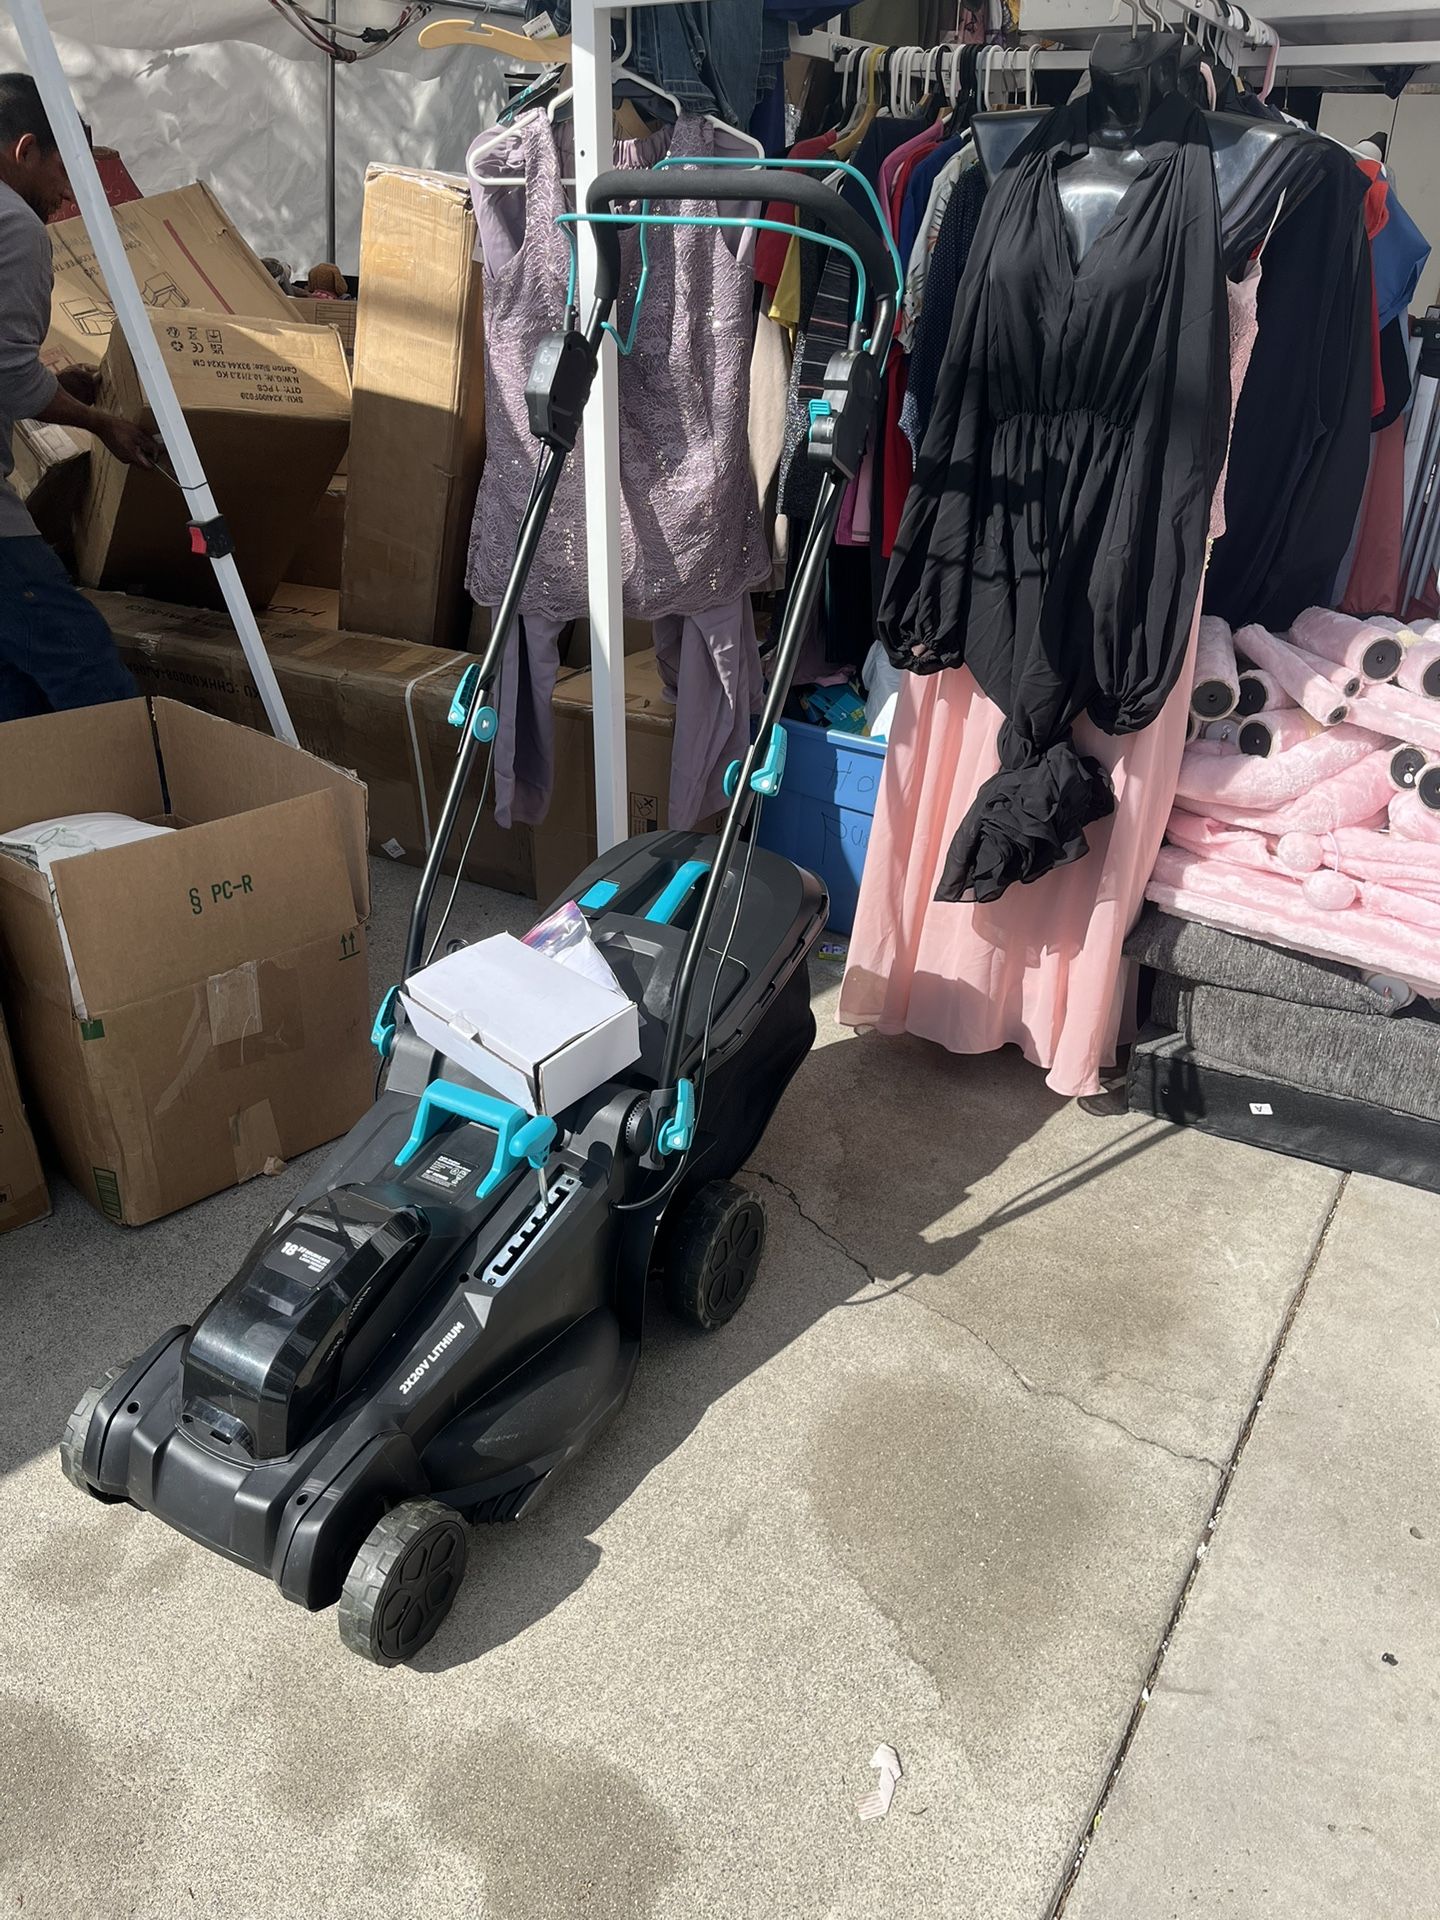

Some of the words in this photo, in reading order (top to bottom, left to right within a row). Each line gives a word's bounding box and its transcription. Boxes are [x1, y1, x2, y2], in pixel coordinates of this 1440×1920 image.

[192, 359, 206, 367] CM
[271, 364, 298, 374] Carton
[256, 384, 274, 392] PCS
[283, 385, 302, 394] QTY:
[284, 395, 304, 404] SKU:
[211, 874, 254, 904] PC-R
[399, 1359, 430, 1394] 2X20V
[427, 1321, 465, 1362] LITHIUM
